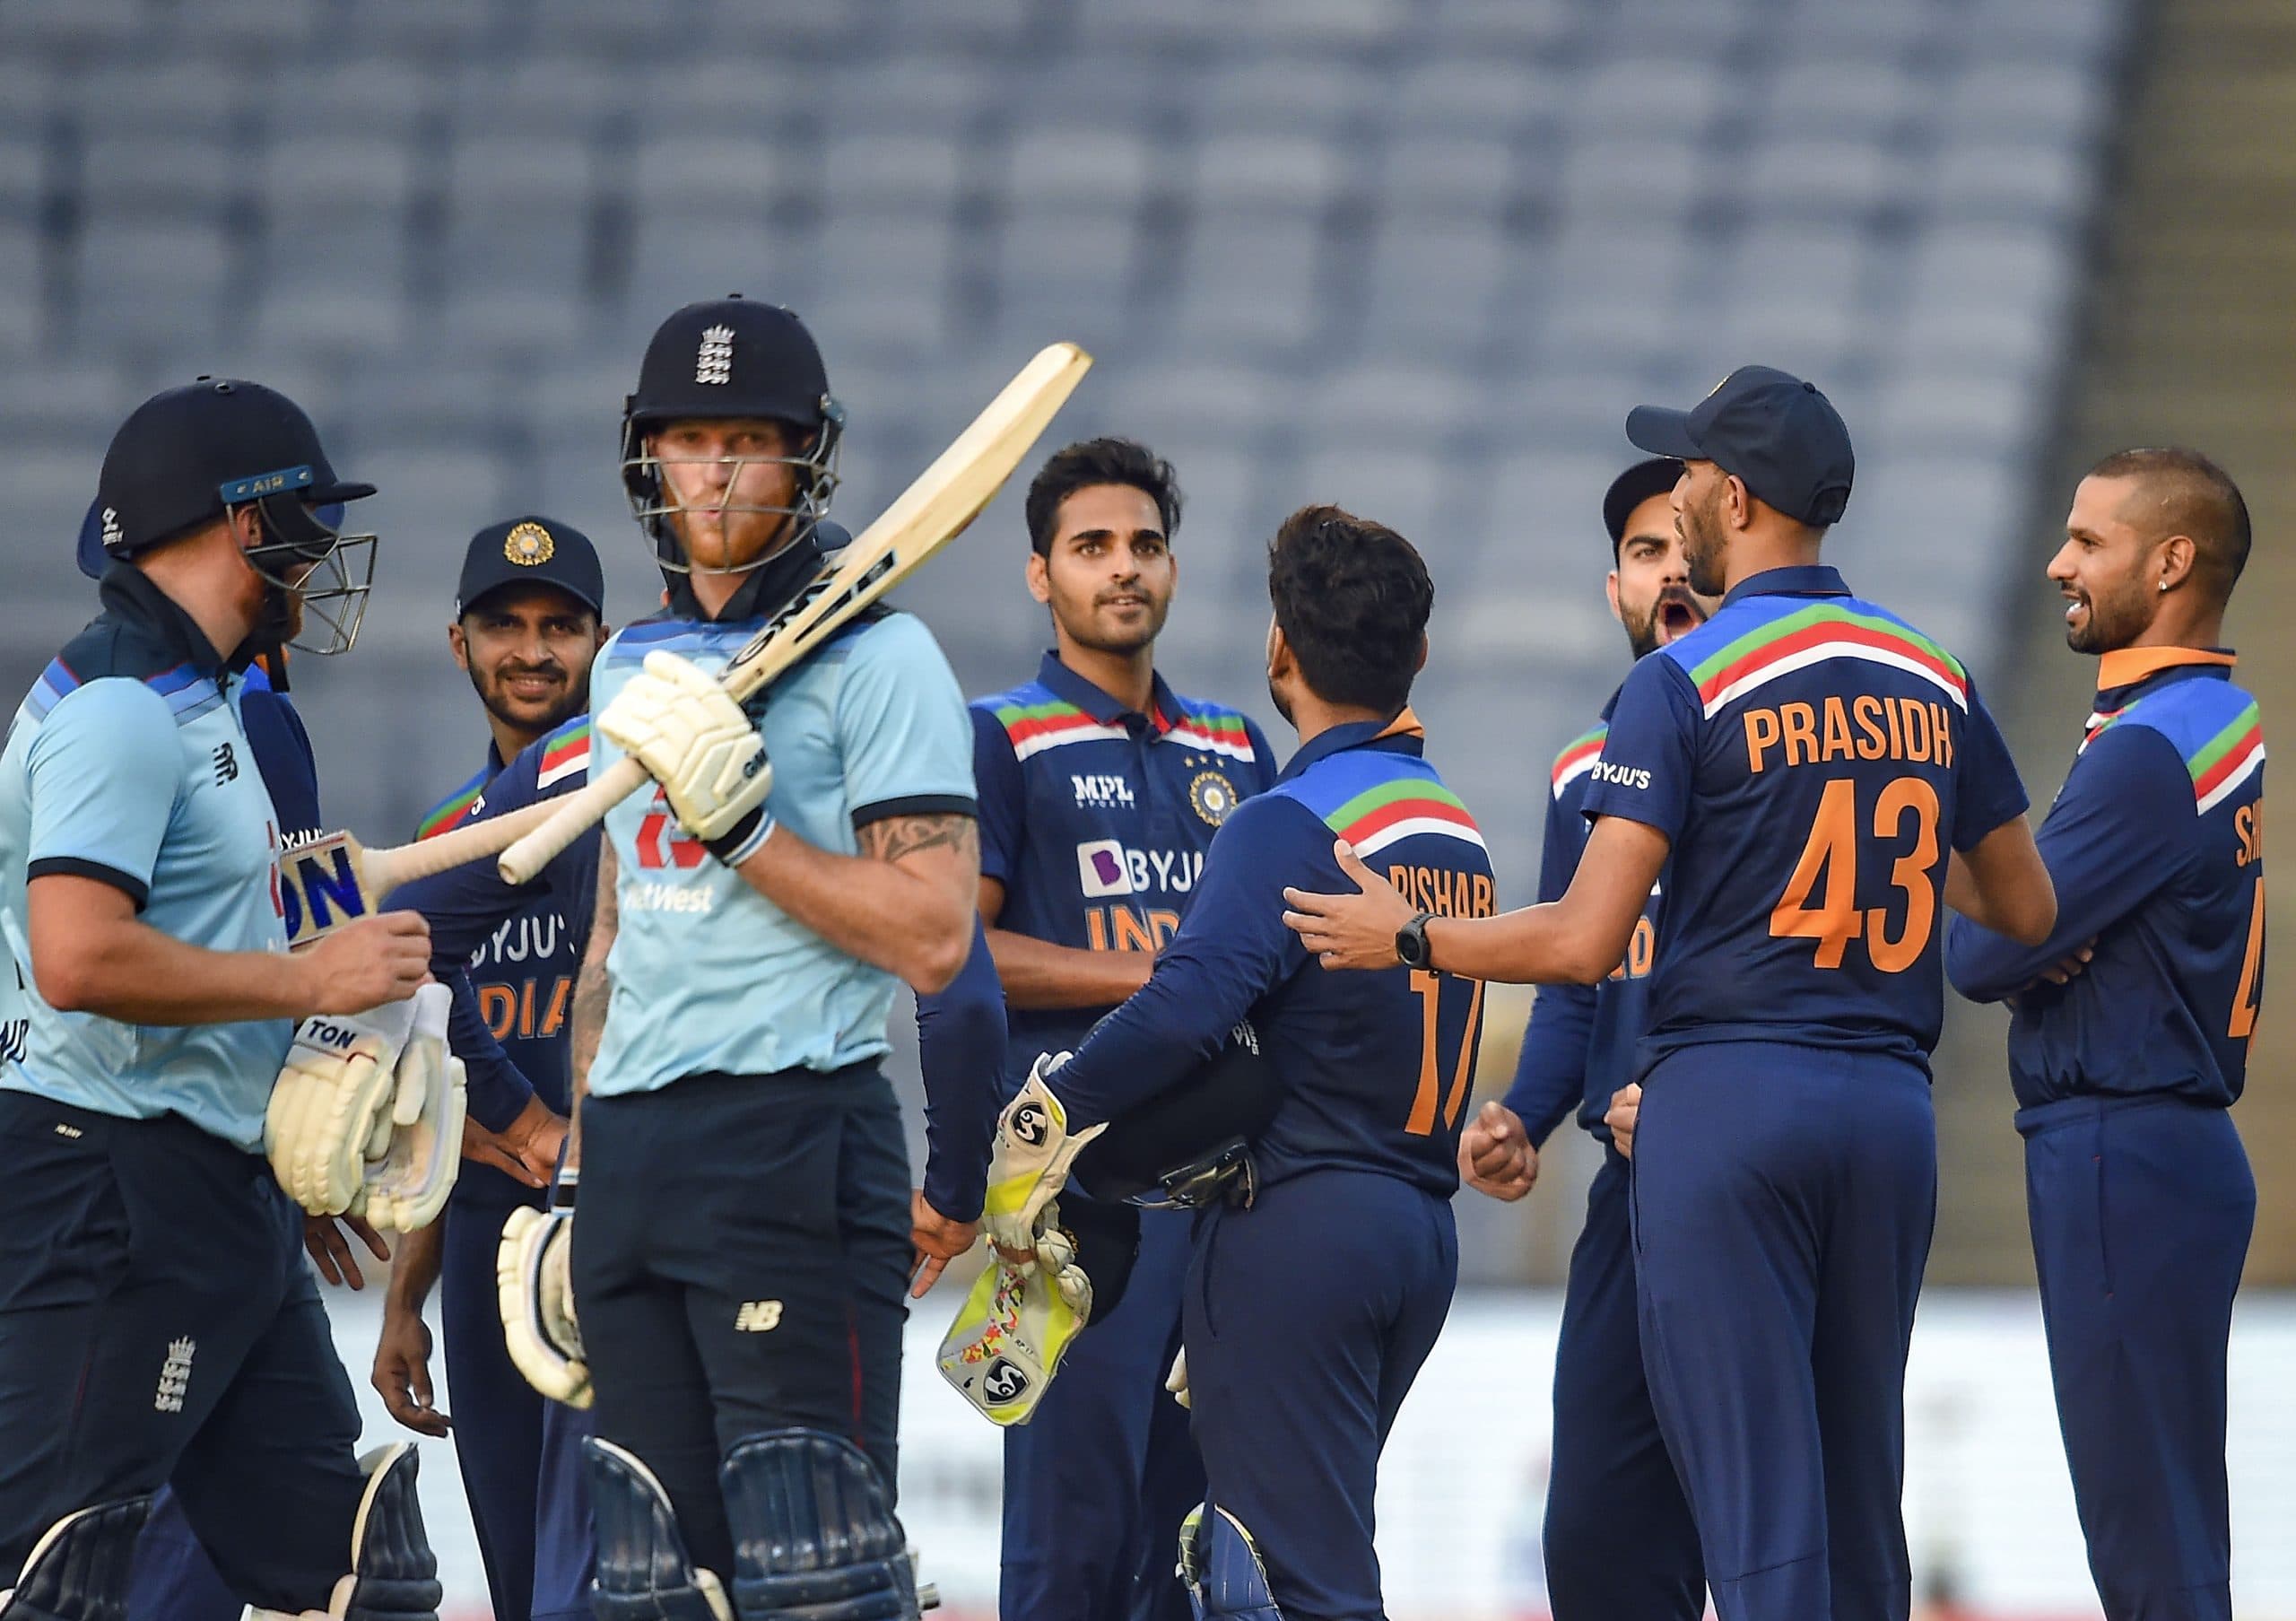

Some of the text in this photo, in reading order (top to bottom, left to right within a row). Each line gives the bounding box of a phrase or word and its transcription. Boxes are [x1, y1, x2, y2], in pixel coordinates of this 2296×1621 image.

[1743, 694, 1953, 773] PRASIDH
[1071, 774, 1135, 801] MPL
[1591, 762, 1651, 790] BYJU'S
[1769, 776, 1940, 973] 43
[308, 1019, 357, 1049] TON
[1405, 969, 1483, 1137] 17
